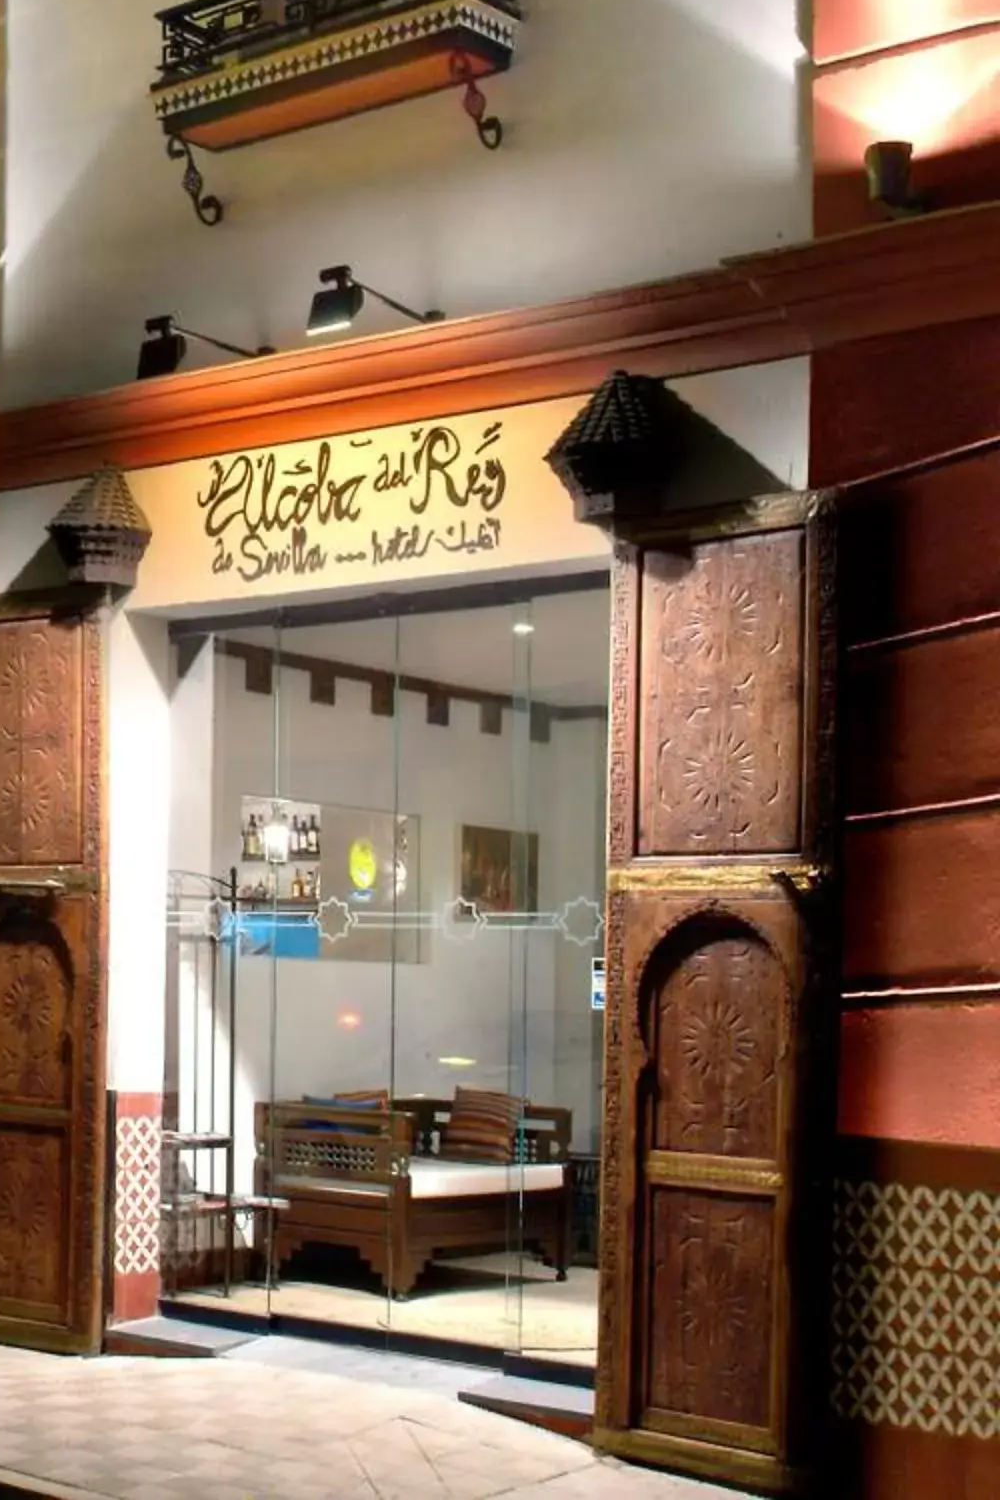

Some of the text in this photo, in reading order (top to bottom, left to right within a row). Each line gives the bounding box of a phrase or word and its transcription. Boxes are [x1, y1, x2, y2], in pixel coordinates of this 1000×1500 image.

[198, 426, 506, 536] Alcoba del Rey
[212, 524, 434, 583] de Sevilla hotel
